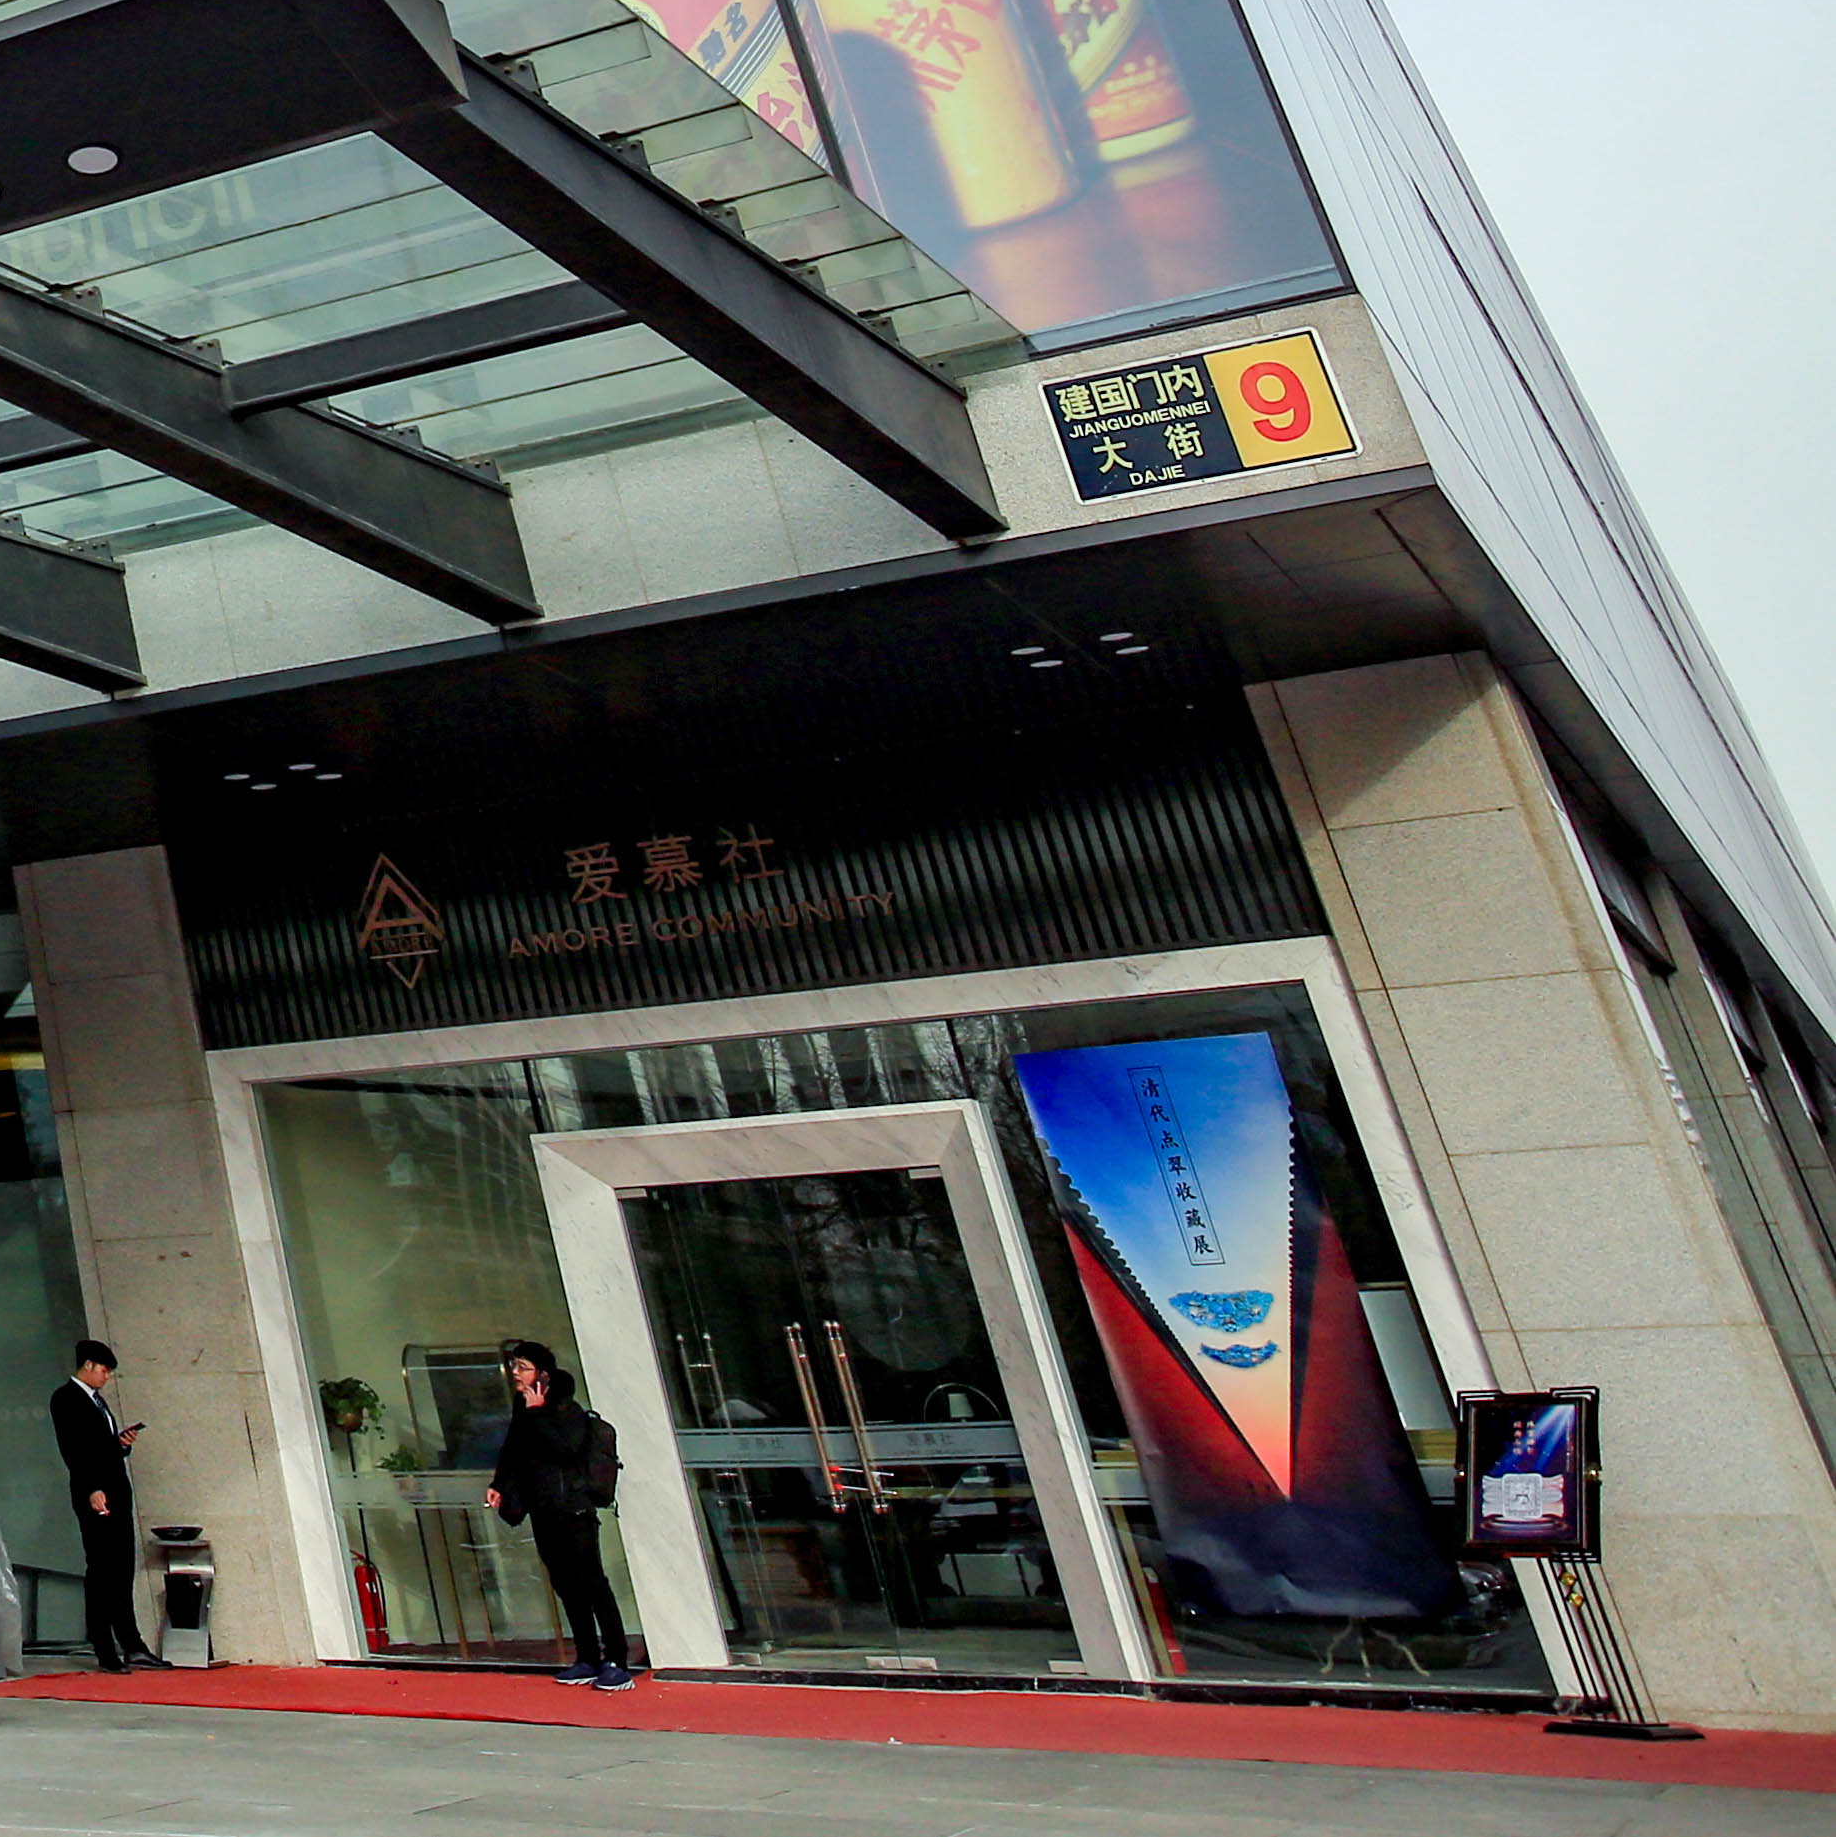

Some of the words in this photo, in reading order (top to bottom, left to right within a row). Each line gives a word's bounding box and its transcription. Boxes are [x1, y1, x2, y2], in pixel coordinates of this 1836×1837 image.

[1054, 363, 1203, 424] 建国门内
[1068, 400, 1212, 439] JIANGUOMENNEI
[1239, 361, 1313, 444] 9
[1092, 421, 1206, 475] 大街
[1128, 463, 1187, 487] DAJIE
[563, 822, 786, 905] 爱慕社
[508, 921, 641, 960] AMORE
[651, 890, 896, 943] COMMUNITY
[1140, 1076, 1215, 1255] 清代点翠收藏展
